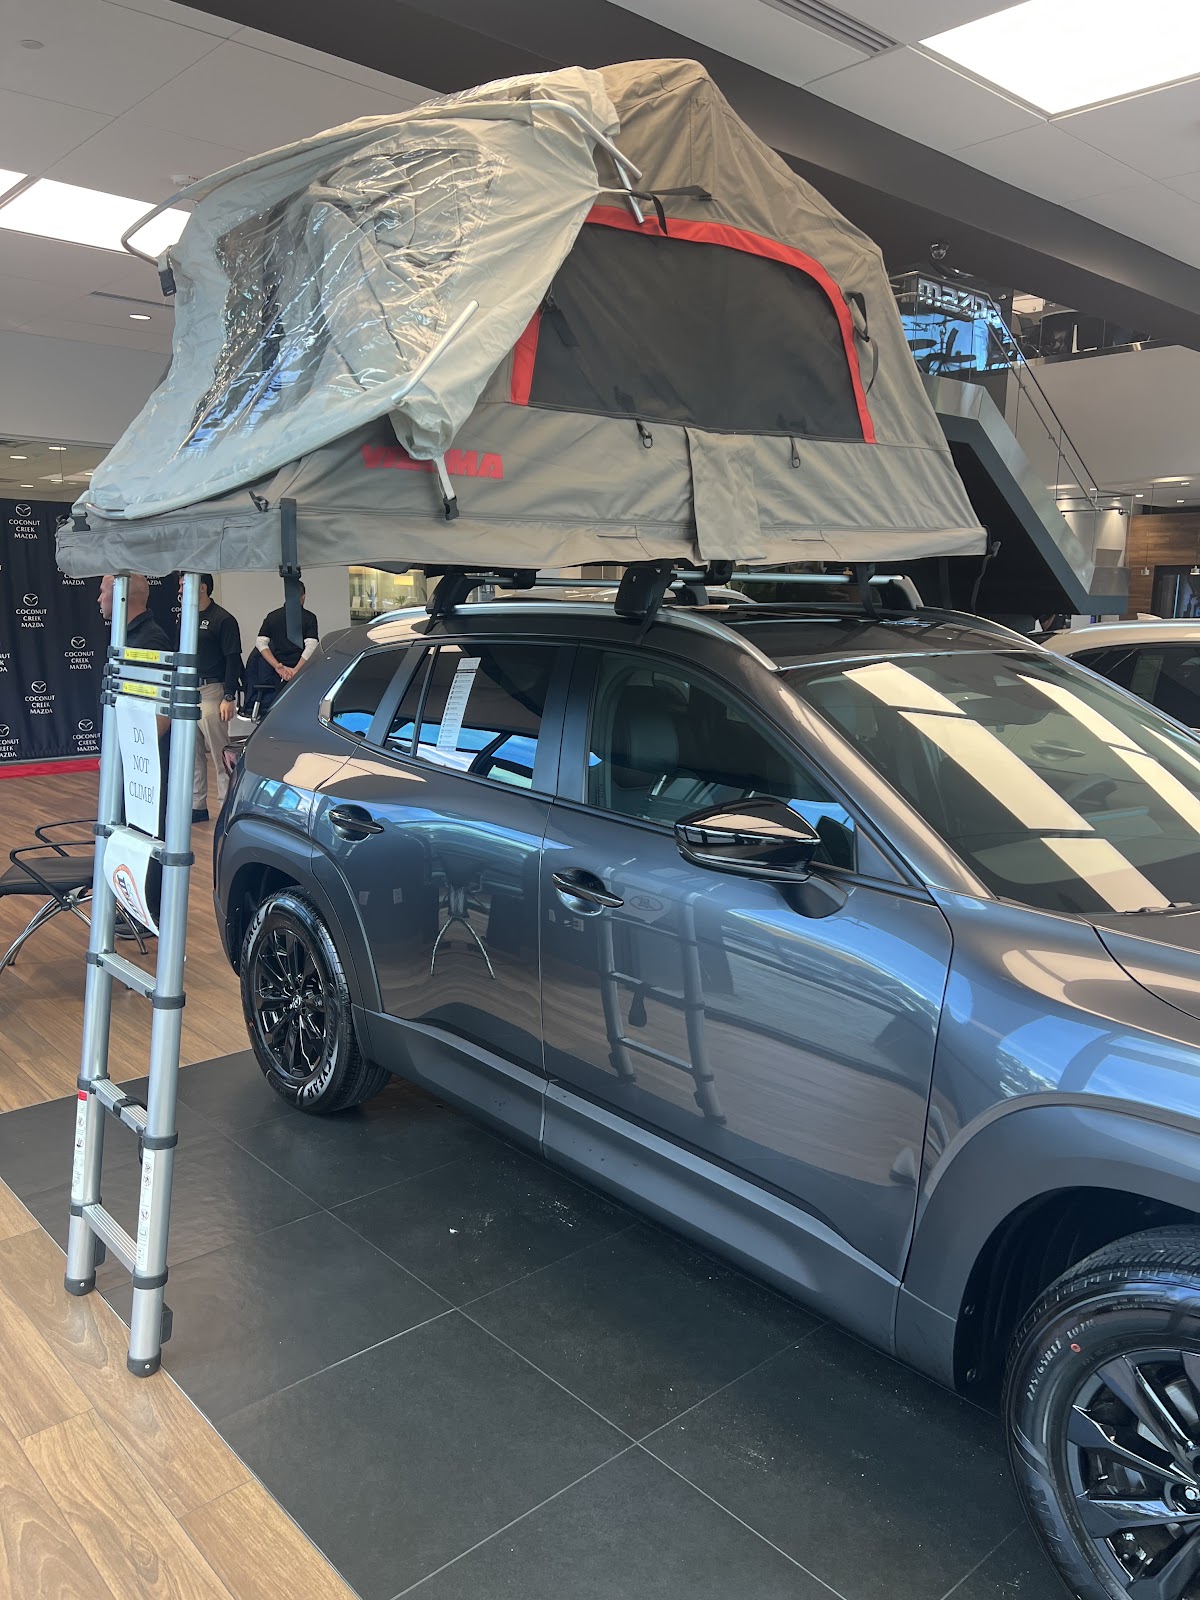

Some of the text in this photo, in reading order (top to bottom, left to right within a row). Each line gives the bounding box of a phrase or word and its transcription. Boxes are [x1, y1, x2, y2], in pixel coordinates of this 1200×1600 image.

[72, 732, 101, 740] COCONUT
[133, 727, 145, 745] DO
[132, 754, 150, 774] NOT
[128, 780, 155, 805] CLIMB!
